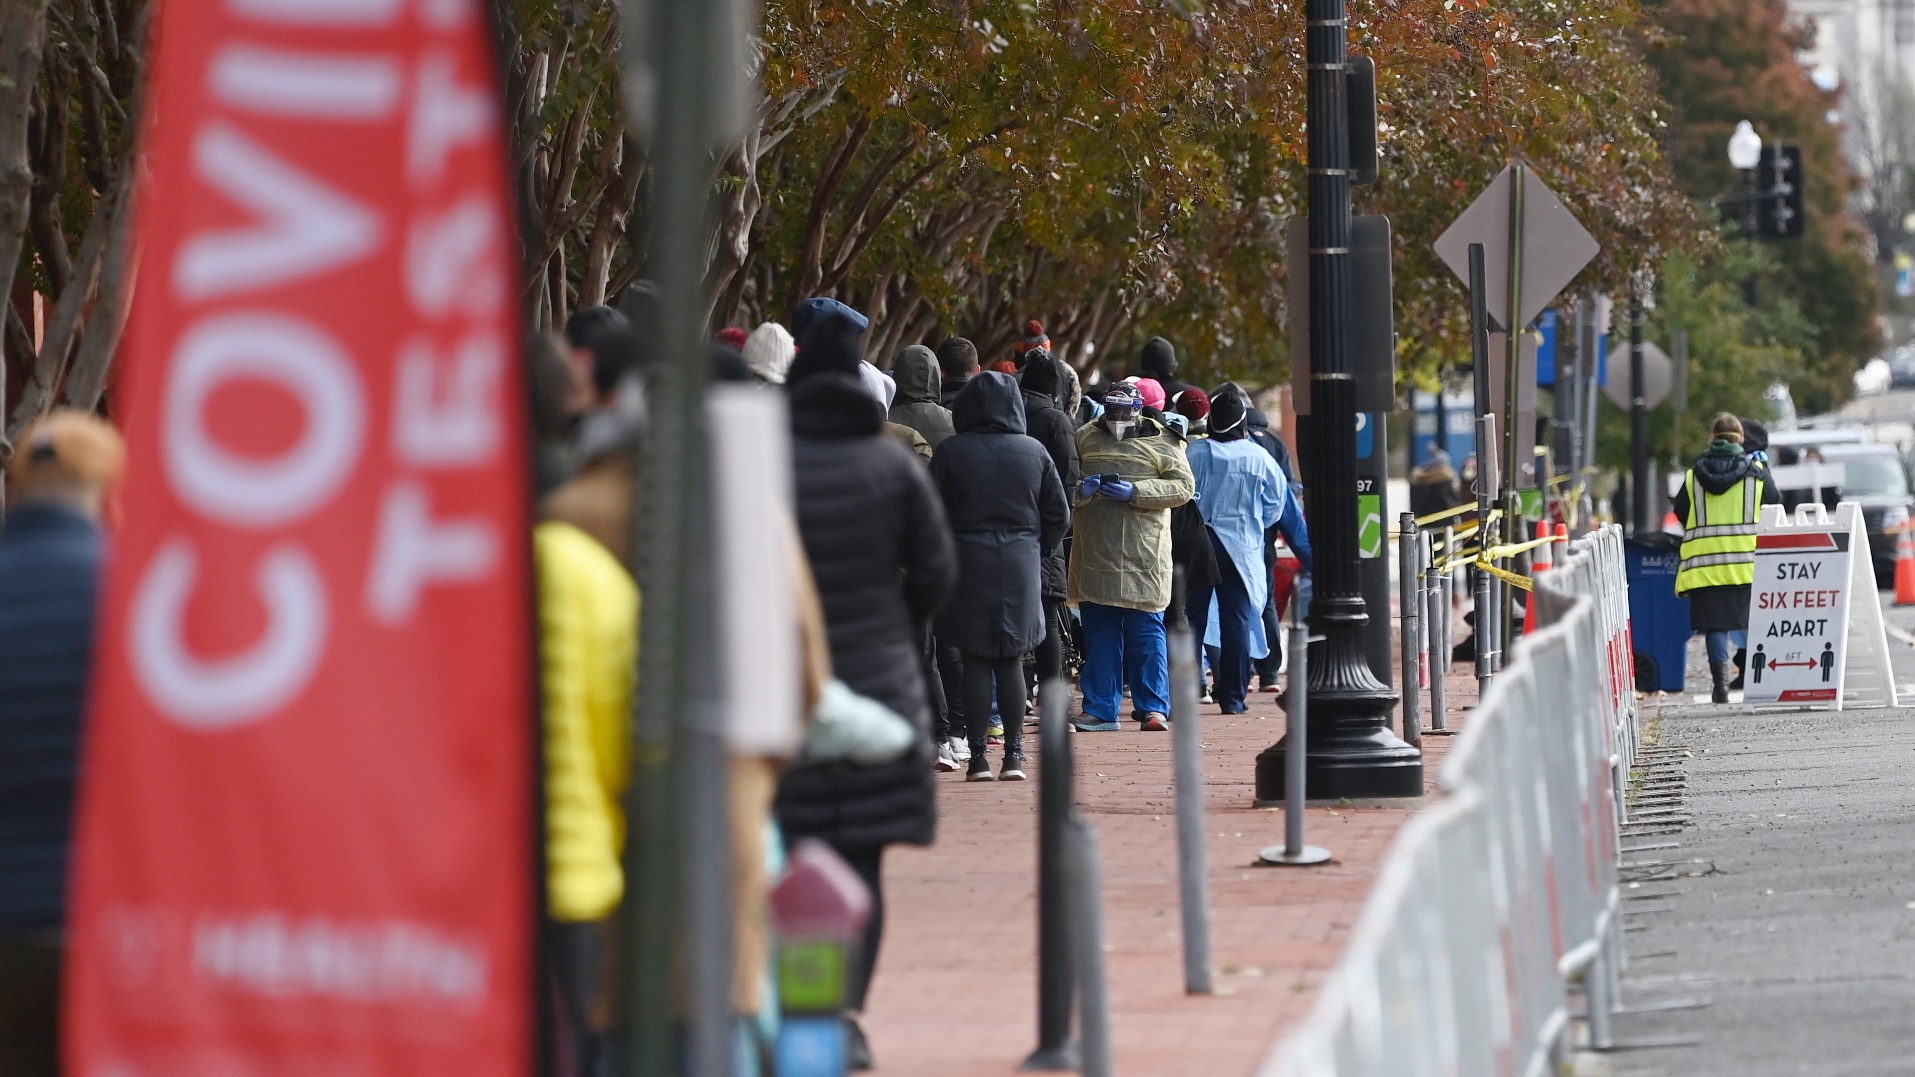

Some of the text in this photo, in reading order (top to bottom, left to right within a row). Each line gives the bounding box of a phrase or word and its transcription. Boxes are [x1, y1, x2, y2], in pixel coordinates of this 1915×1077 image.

[130, 0, 402, 733] COVI
[1776, 561, 1822, 580] STAY
[1758, 590, 1840, 610] SIX FEET
[1766, 619, 1828, 638] APART
[1785, 652, 1802, 661] 6FT
